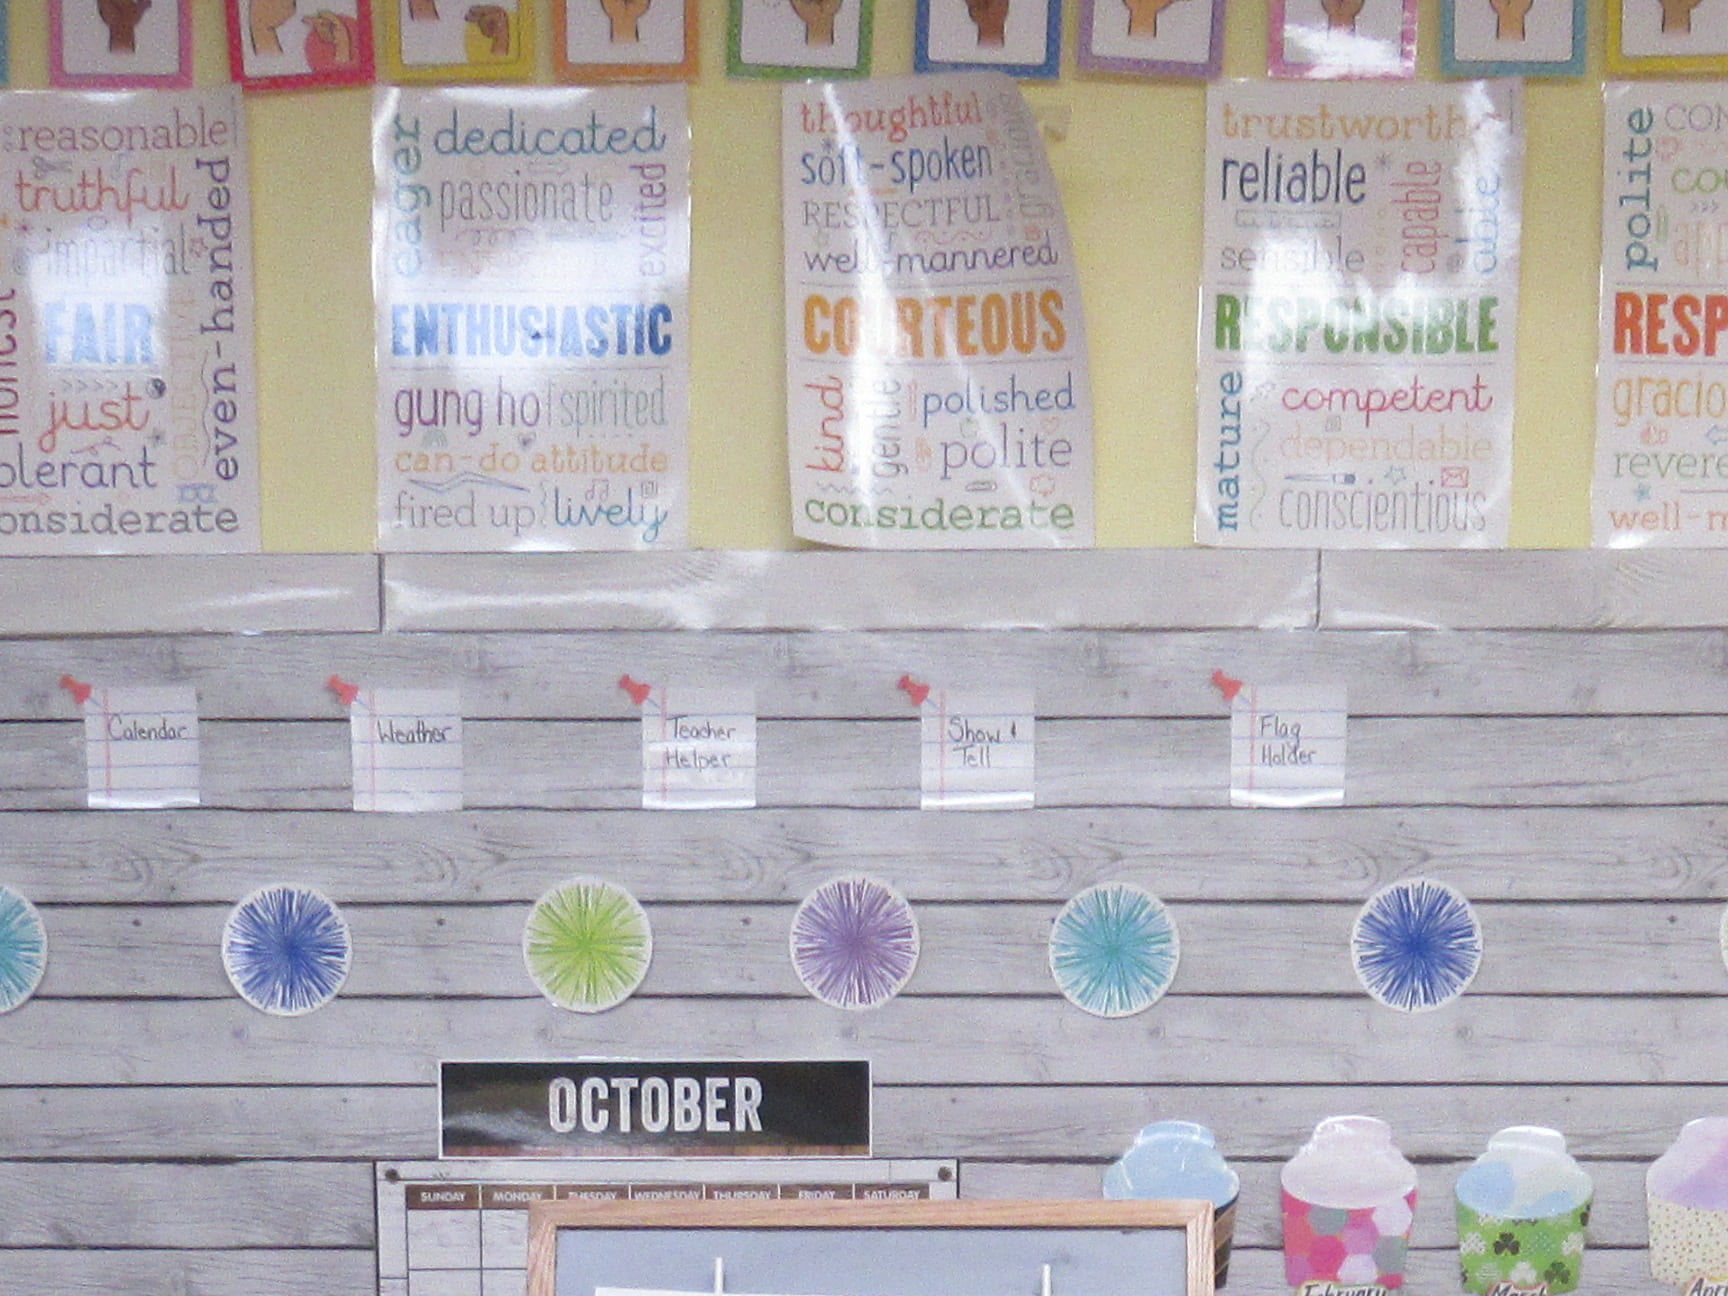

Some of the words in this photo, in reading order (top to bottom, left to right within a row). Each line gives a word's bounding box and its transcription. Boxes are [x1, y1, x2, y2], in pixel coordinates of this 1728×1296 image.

[20, 108, 230, 153] reasonable
[434, 104, 668, 156] dedicated
[801, 92, 984, 143] thoughtful
[1222, 102, 1487, 141] trustworth
[15, 166, 190, 228] truthful
[438, 172, 617, 232] passionate
[1221, 146, 1369, 206] reliable
[1618, 105, 1660, 272] polite
[629, 162, 669, 279] excited
[1390, 161, 1450, 275] capable
[44, 303, 155, 364] FAIR
[196, 155, 240, 482] even-handed
[390, 303, 673, 358] ENTHUSIASTIC
[803, 289, 1068, 358] CORTEOUS
[1216, 295, 1501, 354] RSPONSIBLE
[37, 386, 150, 454] just
[393, 387, 483, 437] gung
[496, 376, 541, 428] ho
[560, 375, 669, 437] spirited
[804, 376, 846, 475] kind
[921, 373, 1077, 428] polished
[1280, 375, 1494, 430] competent
[531, 440, 668, 473] attitude
[940, 423, 1075, 480] polite
[1212, 370, 1246, 532] mature
[1278, 425, 1494, 465] dependable
[394, 489, 476, 530] fired
[490, 502, 537, 537] up
[554, 485, 669, 542] lively
[803, 497, 1076, 532] considerate
[1278, 482, 1488, 534] conscientious
[106, 712, 188, 741] Calendar
[376, 719, 453, 745] Weather
[666, 715, 737, 742] Teacher
[948, 713, 1001, 744] Show
[1261, 711, 1302, 749] Flag
[668, 744, 733, 772] Helper
[953, 746, 992, 769] Tell
[1262, 743, 1317, 768] Holder
[548, 1076, 765, 1135] OCTOBER
[420, 1191, 467, 1203] SUNDAY
[493, 1191, 543, 1202] MONDAY
[634, 1191, 702, 1202] WEDNESDAY
[798, 1190, 837, 1202] FRIDAY
[863, 1190, 921, 1202] SATURDAY
